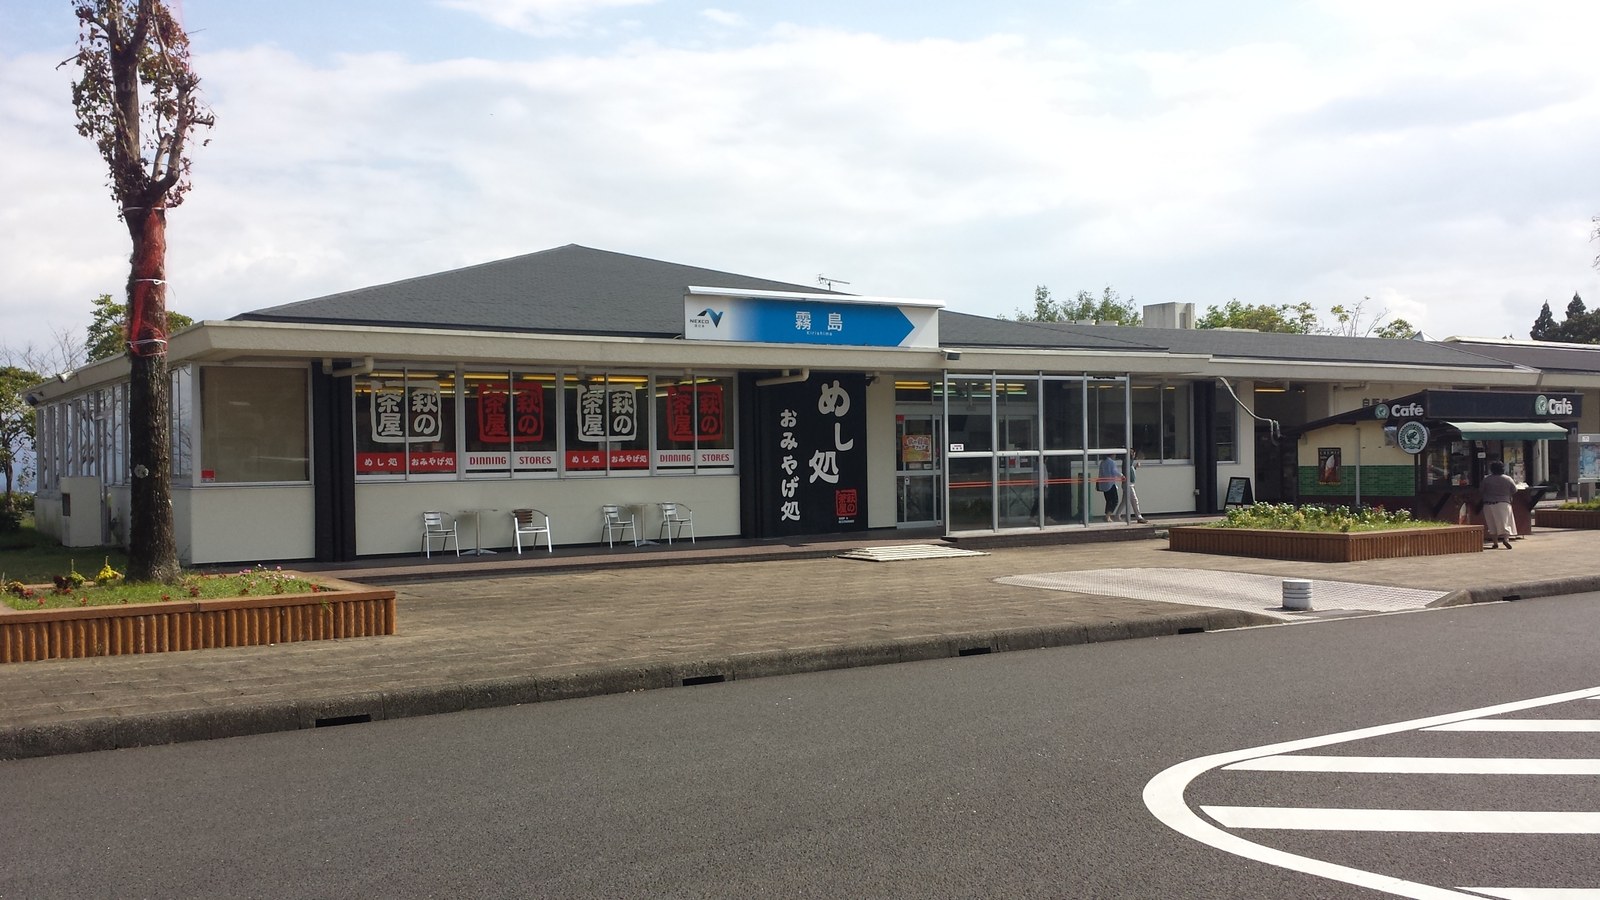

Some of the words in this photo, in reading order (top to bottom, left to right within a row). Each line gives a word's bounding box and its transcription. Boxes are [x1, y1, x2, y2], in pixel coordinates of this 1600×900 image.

[795, 311, 843, 331] 霧島
[808, 380, 854, 484] めし処
[364, 457, 398, 466] めし処
[411, 456, 454, 466] おみやげ処
[469, 456, 507, 465] DINNING
[519, 456, 551, 465] STORES
[571, 455, 600, 464] めし処
[611, 454, 647, 463] おみやげ処
[660, 454, 692, 463] DINNING
[702, 453, 730, 462] STORES
[780, 409, 801, 521] おみやげ処
